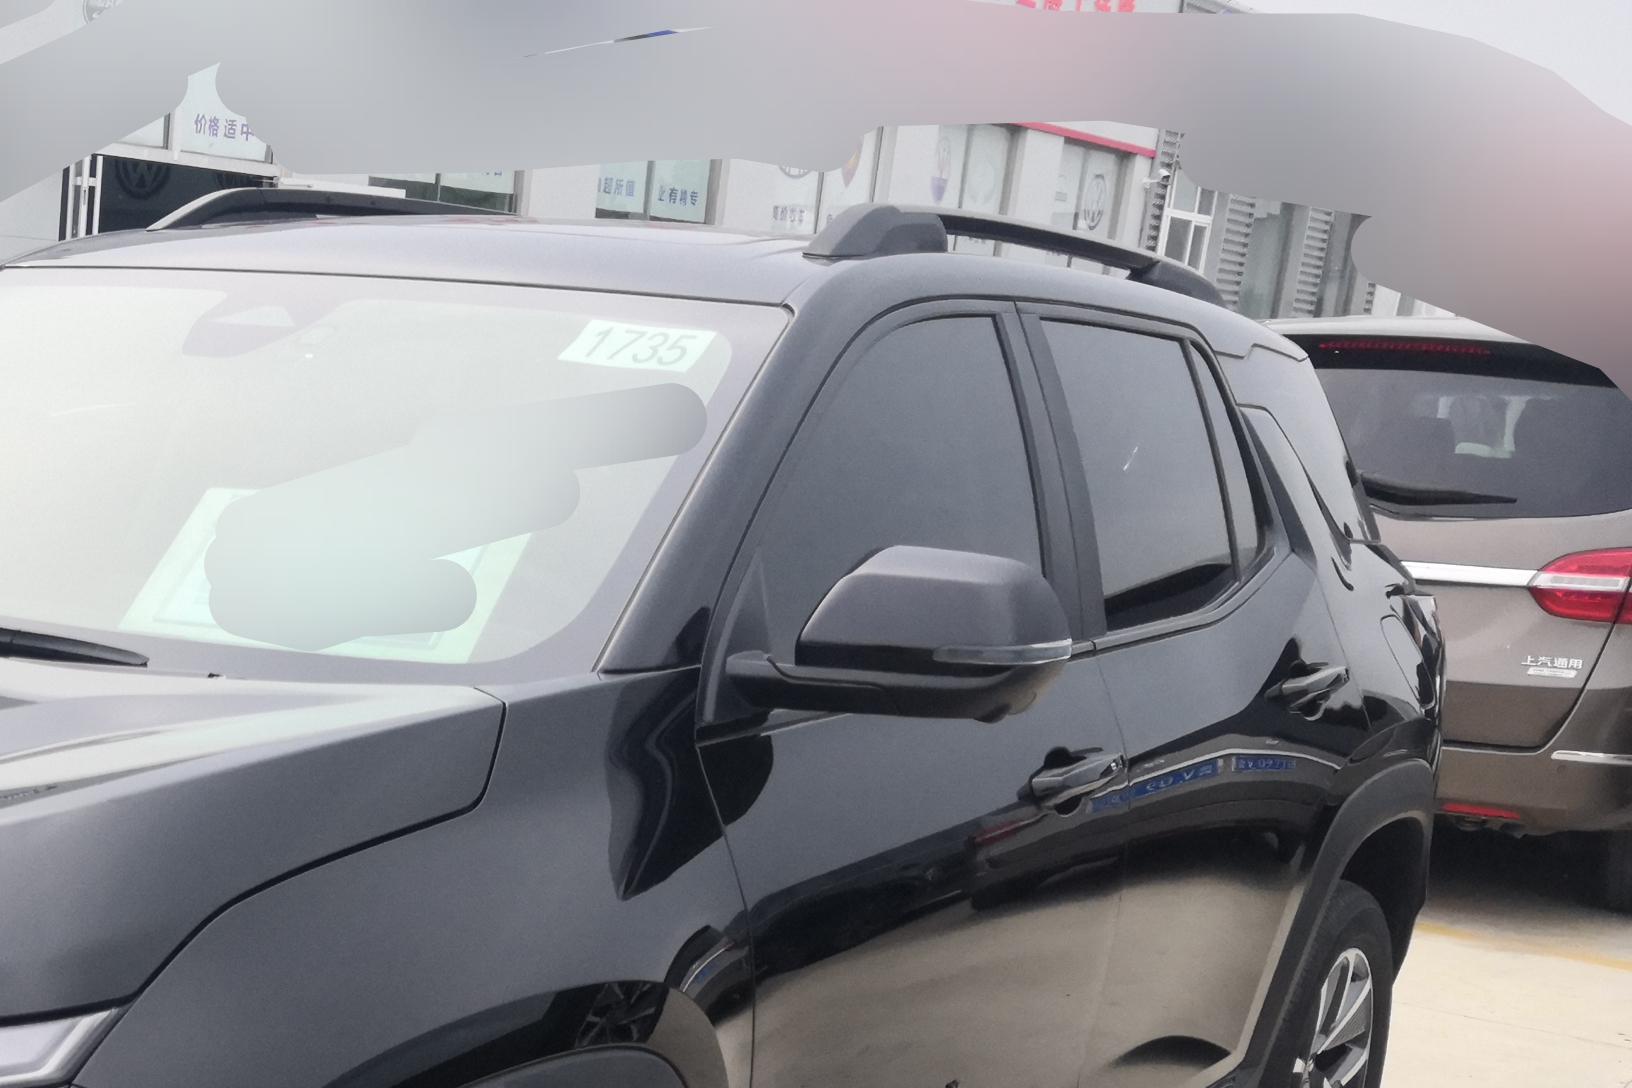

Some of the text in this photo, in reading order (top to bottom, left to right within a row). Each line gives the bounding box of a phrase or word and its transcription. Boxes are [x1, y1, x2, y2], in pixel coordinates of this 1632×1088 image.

[194, 113, 254, 141] 价格适中
[584, 326, 698, 366] 1735
[1521, 655, 1583, 669] 上汽通用
